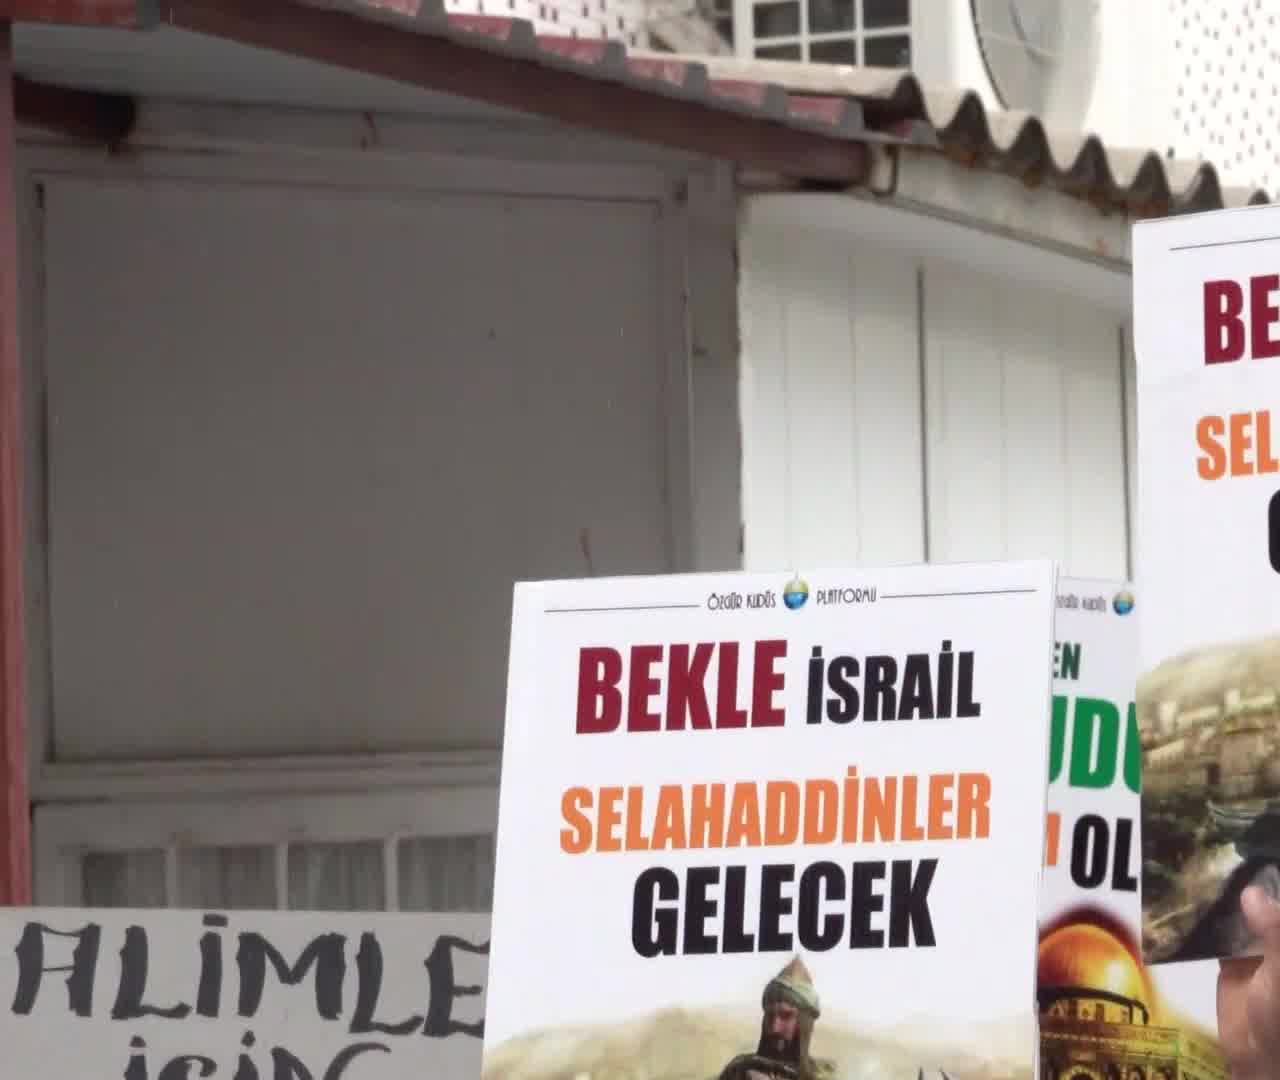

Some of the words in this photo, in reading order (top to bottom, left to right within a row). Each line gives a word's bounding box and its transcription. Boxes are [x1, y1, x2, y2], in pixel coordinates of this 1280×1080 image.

[576, 640, 788, 735] BEKLE
[806, 640, 981, 725] İSRAİL
[560, 766, 992, 854] SELAHADDİNLER
[631, 858, 938, 958] GELECEK
